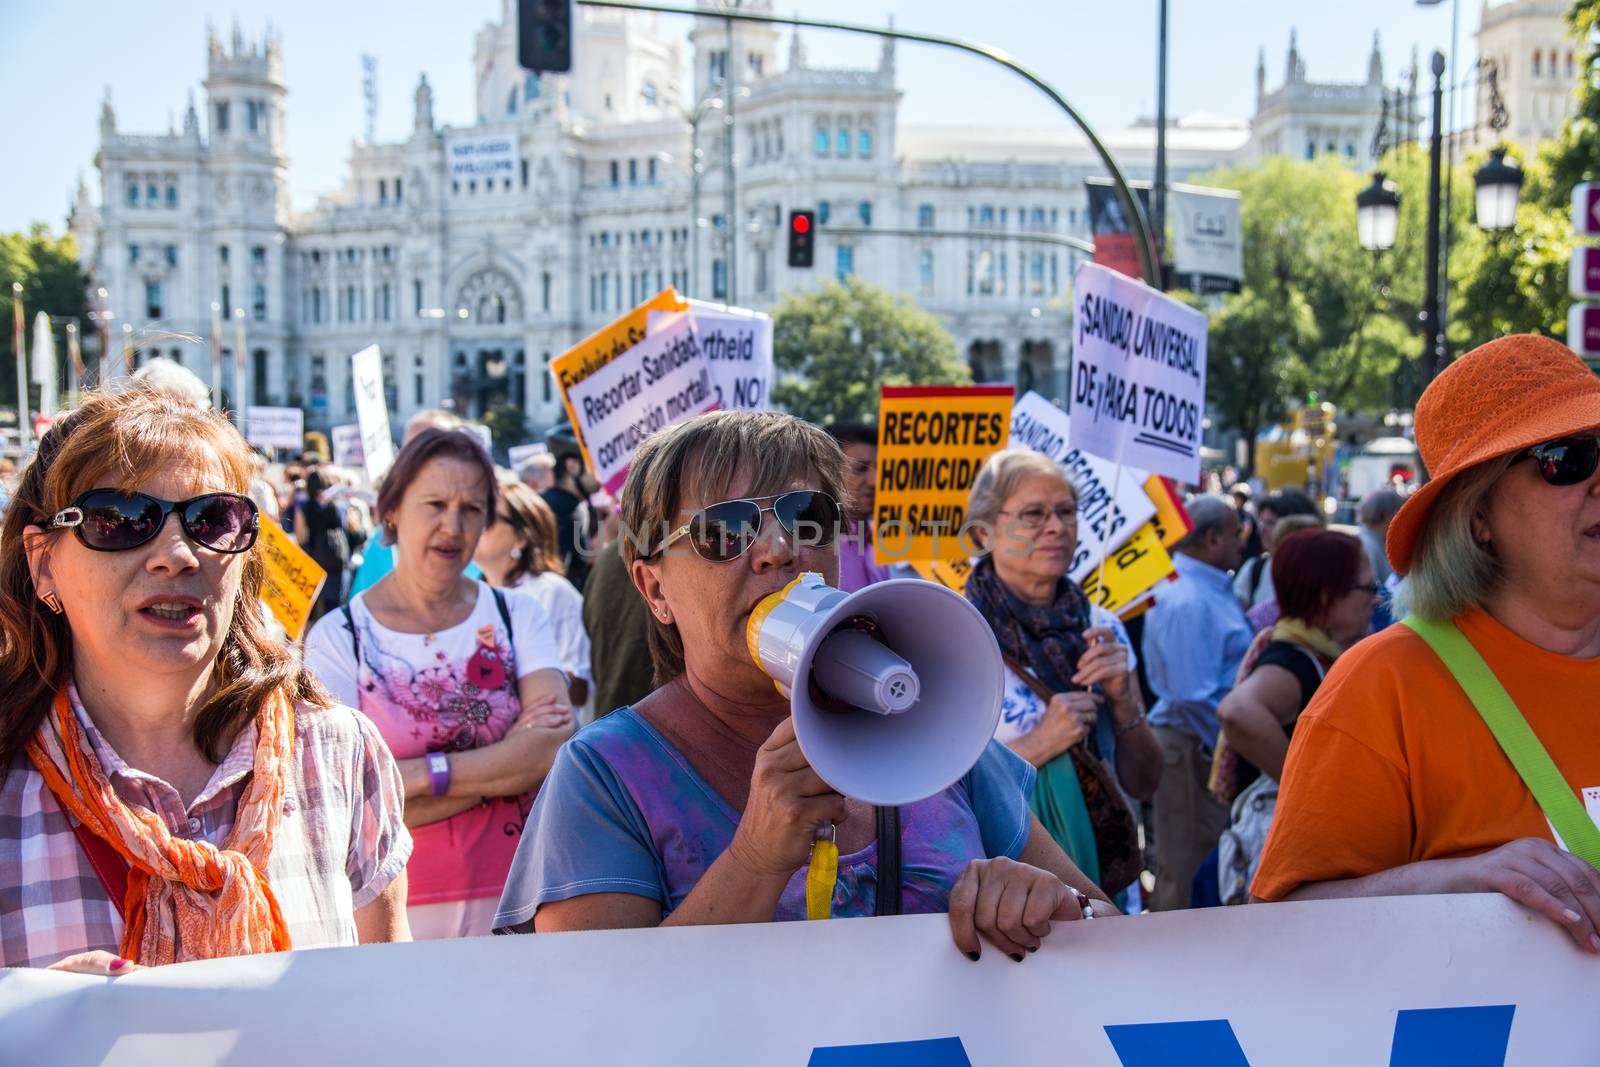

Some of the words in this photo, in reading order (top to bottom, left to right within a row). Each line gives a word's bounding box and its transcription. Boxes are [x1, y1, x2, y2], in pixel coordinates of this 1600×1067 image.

[583, 369, 641, 428] Recortar
[1076, 360, 1097, 408] DE
[1102, 372, 1137, 424] PARA
[1142, 386, 1199, 442] TODOS!
[883, 411, 1003, 446] RECORTES
[878, 505, 902, 538] EN
[906, 504, 964, 538] SANID
